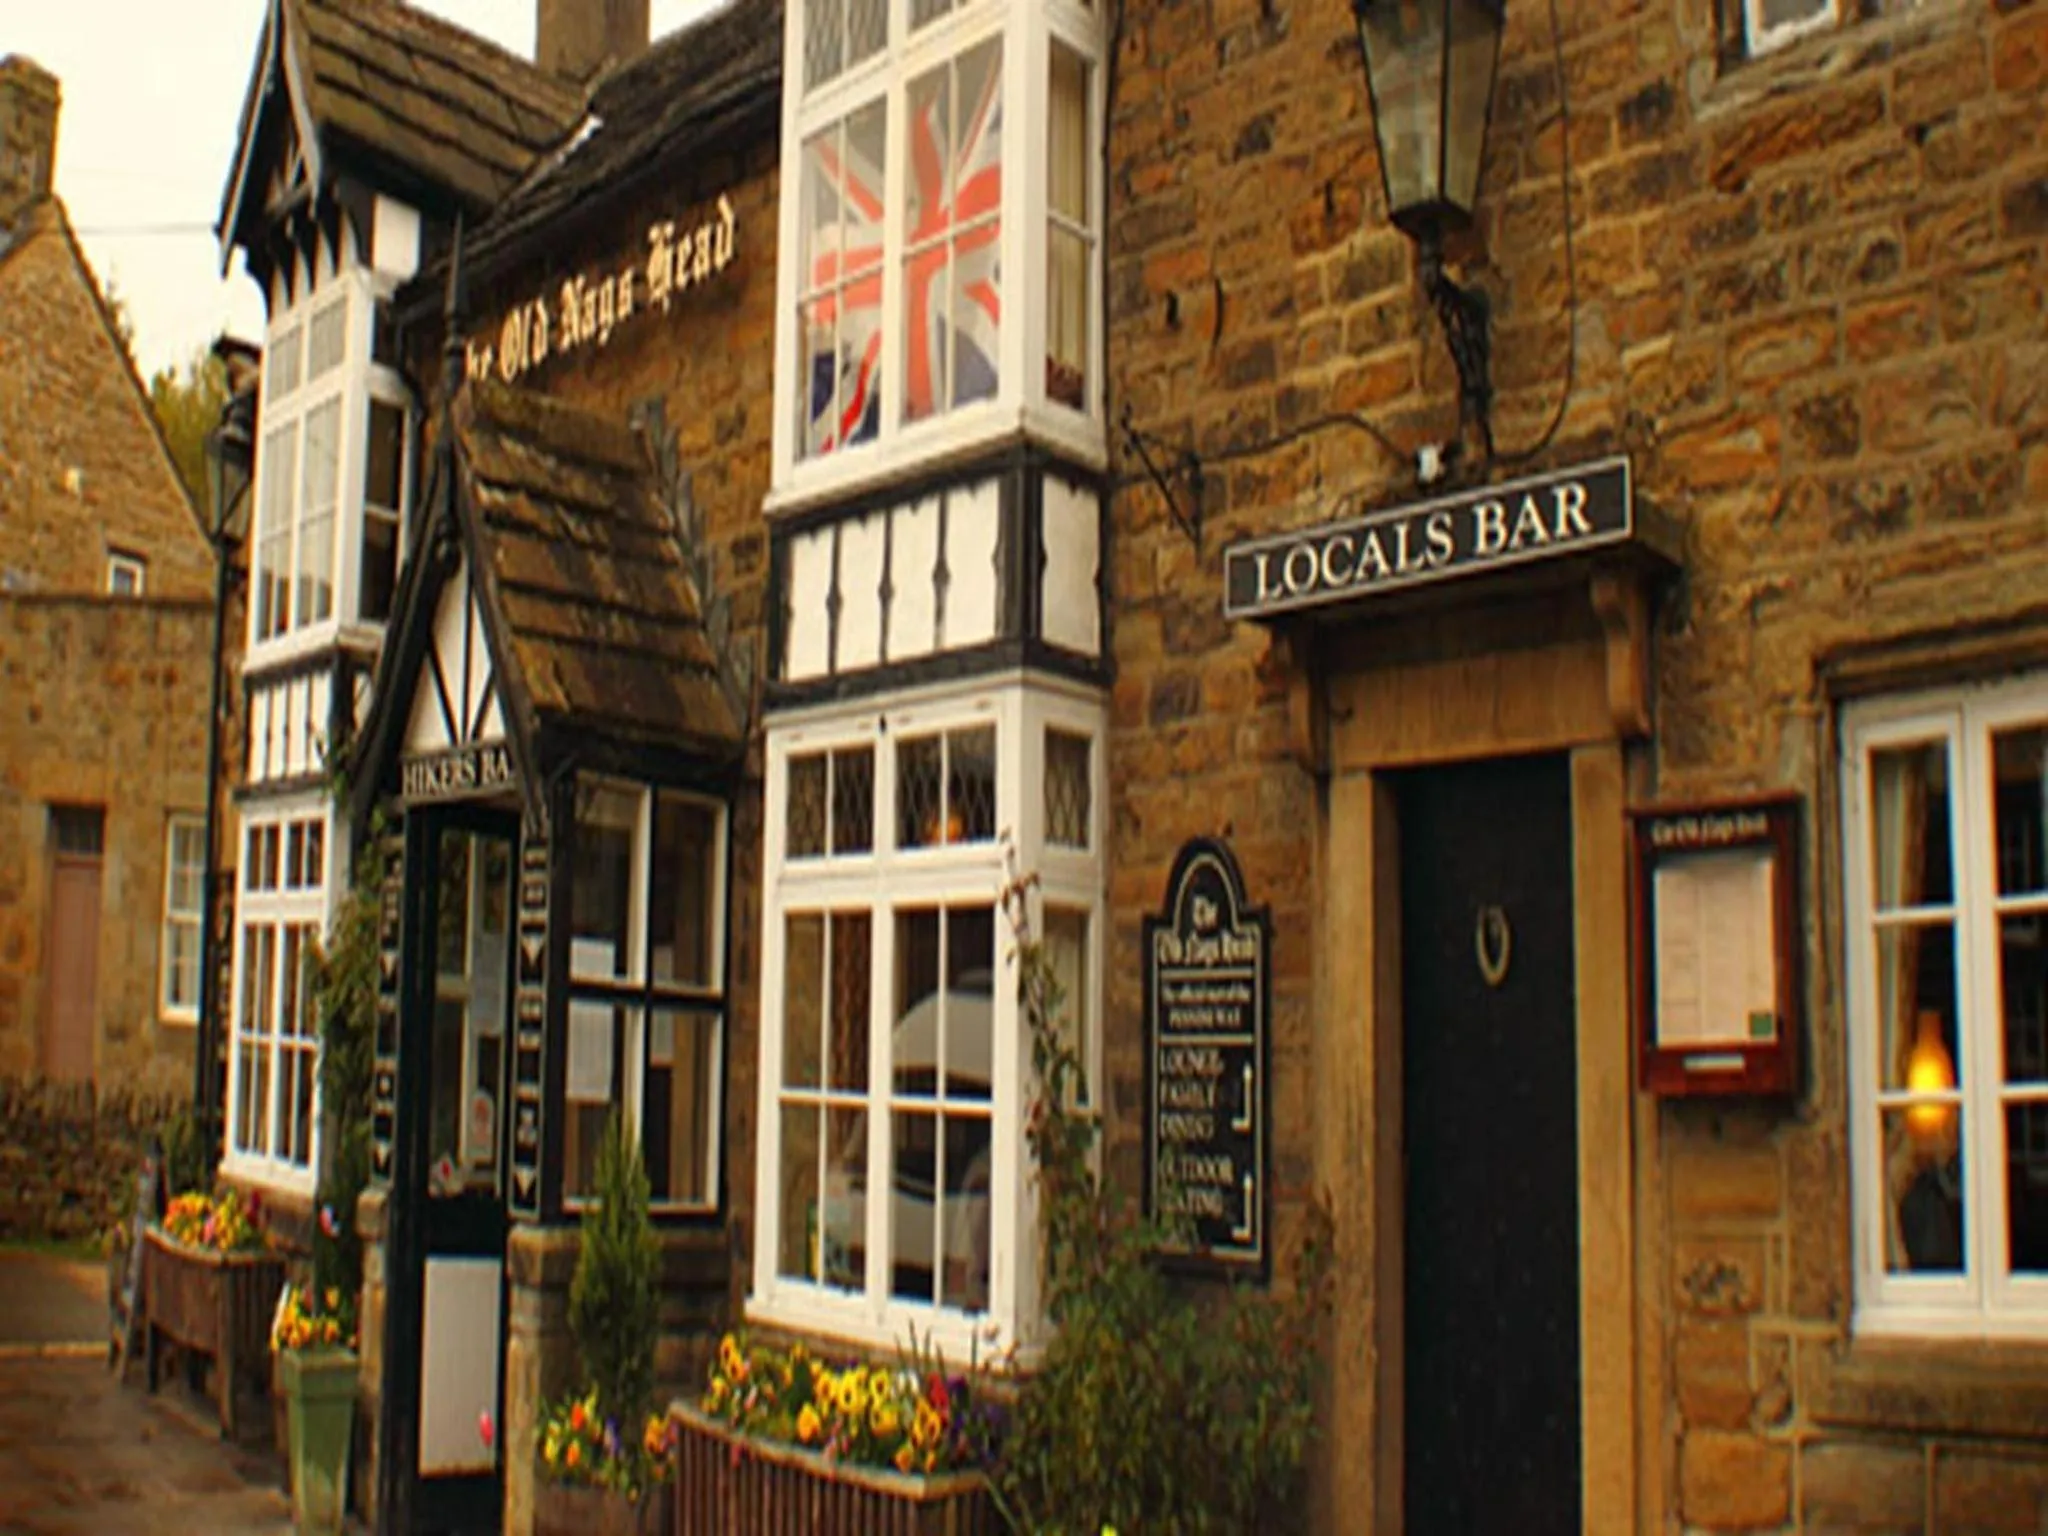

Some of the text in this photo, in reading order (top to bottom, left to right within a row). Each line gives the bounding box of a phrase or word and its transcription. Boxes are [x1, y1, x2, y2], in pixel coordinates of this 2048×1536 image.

[500, 294, 548, 384] Old
[559, 266, 634, 352] Nags
[647, 192, 735, 315] Head
[1253, 481, 1592, 602] LOCALS BAR
[481, 748, 510, 785] BA
